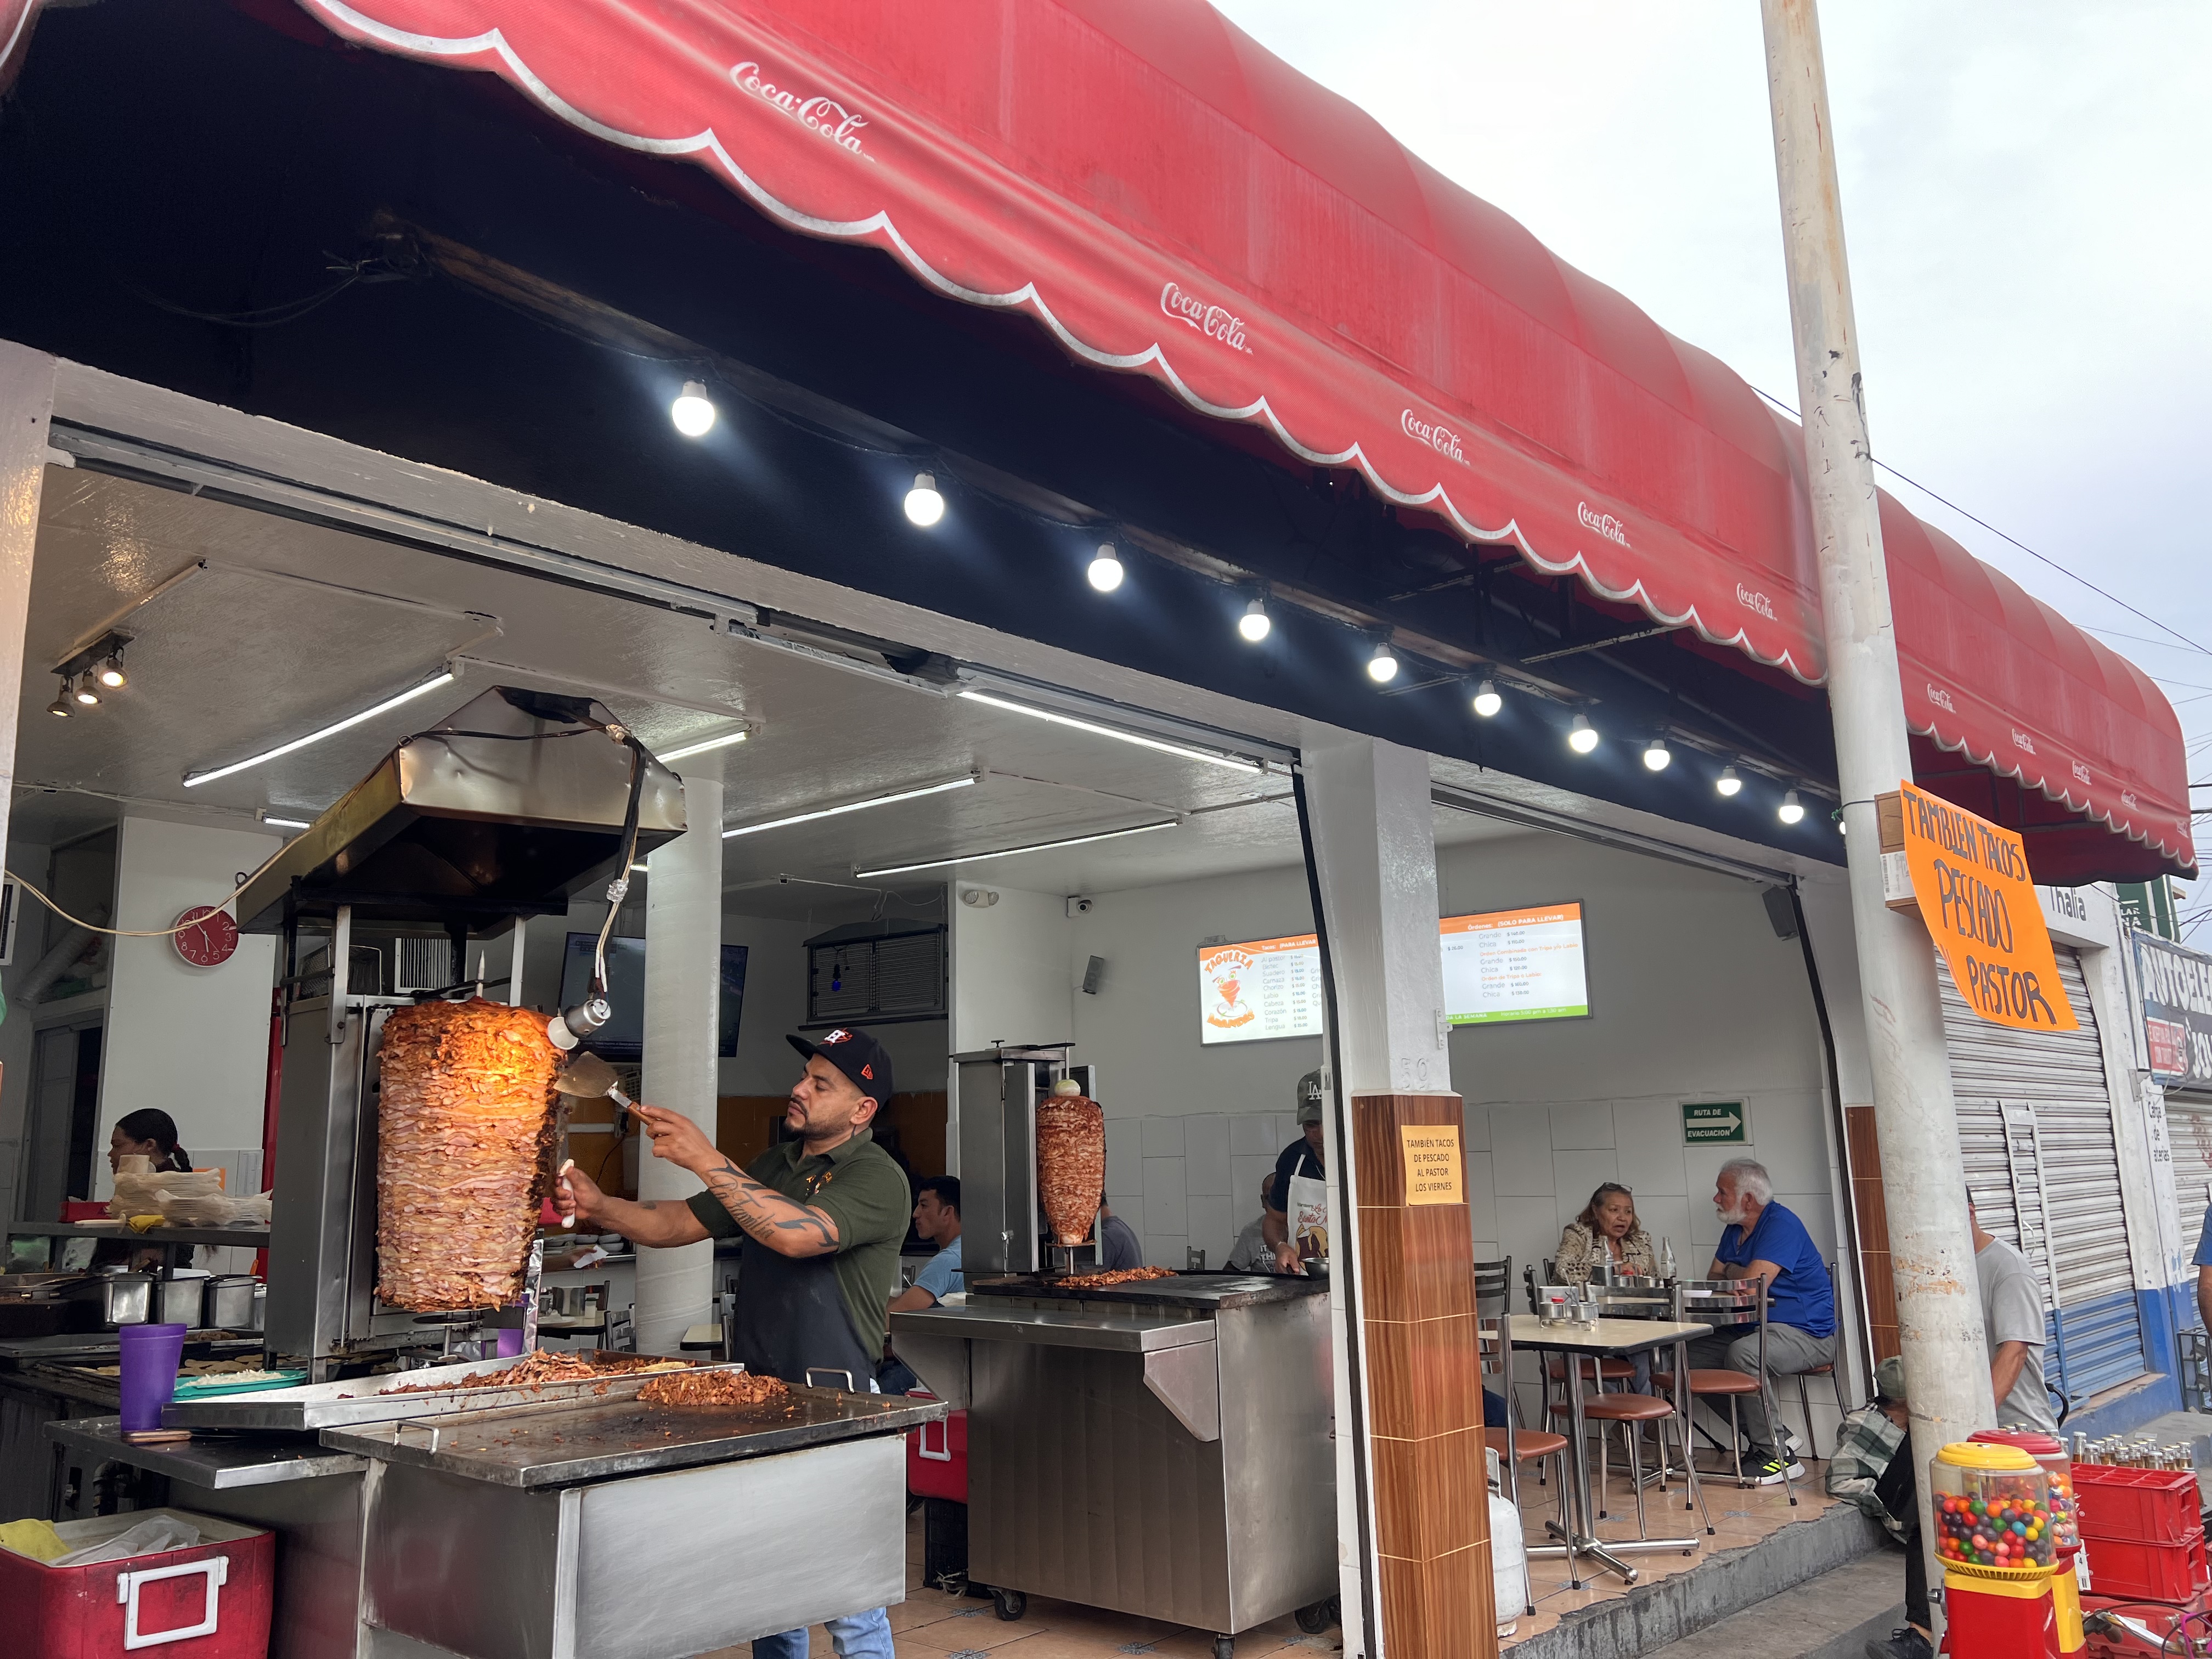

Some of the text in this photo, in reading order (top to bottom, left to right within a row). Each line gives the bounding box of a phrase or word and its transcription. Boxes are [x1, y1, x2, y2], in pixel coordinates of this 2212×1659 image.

[729, 61, 870, 154] Coca-Cola
[1160, 282, 1246, 351] Coca-Cola
[1401, 409, 1464, 463] Coca-Cola
[1577, 501, 1626, 546] Coca-Cola
[1736, 583, 1774, 619] Coca-Cola
[1927, 684, 1954, 713] Coca-Cola
[1903, 789, 1978, 864] TAMBIEN
[1977, 823, 2026, 881] TACOS
[1933, 859, 2013, 953] PESCADO
[1498, 919, 1517, 927] (SOLO
[1537, 914, 1564, 922] LLEVAR)
[225, 933, 232, 941] 3
[182, 941, 188, 951] 8
[190, 950, 196, 958] 7
[201, 954, 208, 962] 6
[213, 951, 220, 960] 5
[1966, 955, 2057, 1025] PASTOR
[1307, 1081, 1322, 1100] LA
[1688, 1129, 1730, 1137] EVACUACION
[1407, 1137, 1454, 1148] TAMBIÉN TACOS
[1414, 1153, 1449, 1163] DE PESCADO
[1417, 1167, 1449, 1177] AL PASTOR
[1415, 1182, 1452, 1192] LOS VIERNES
